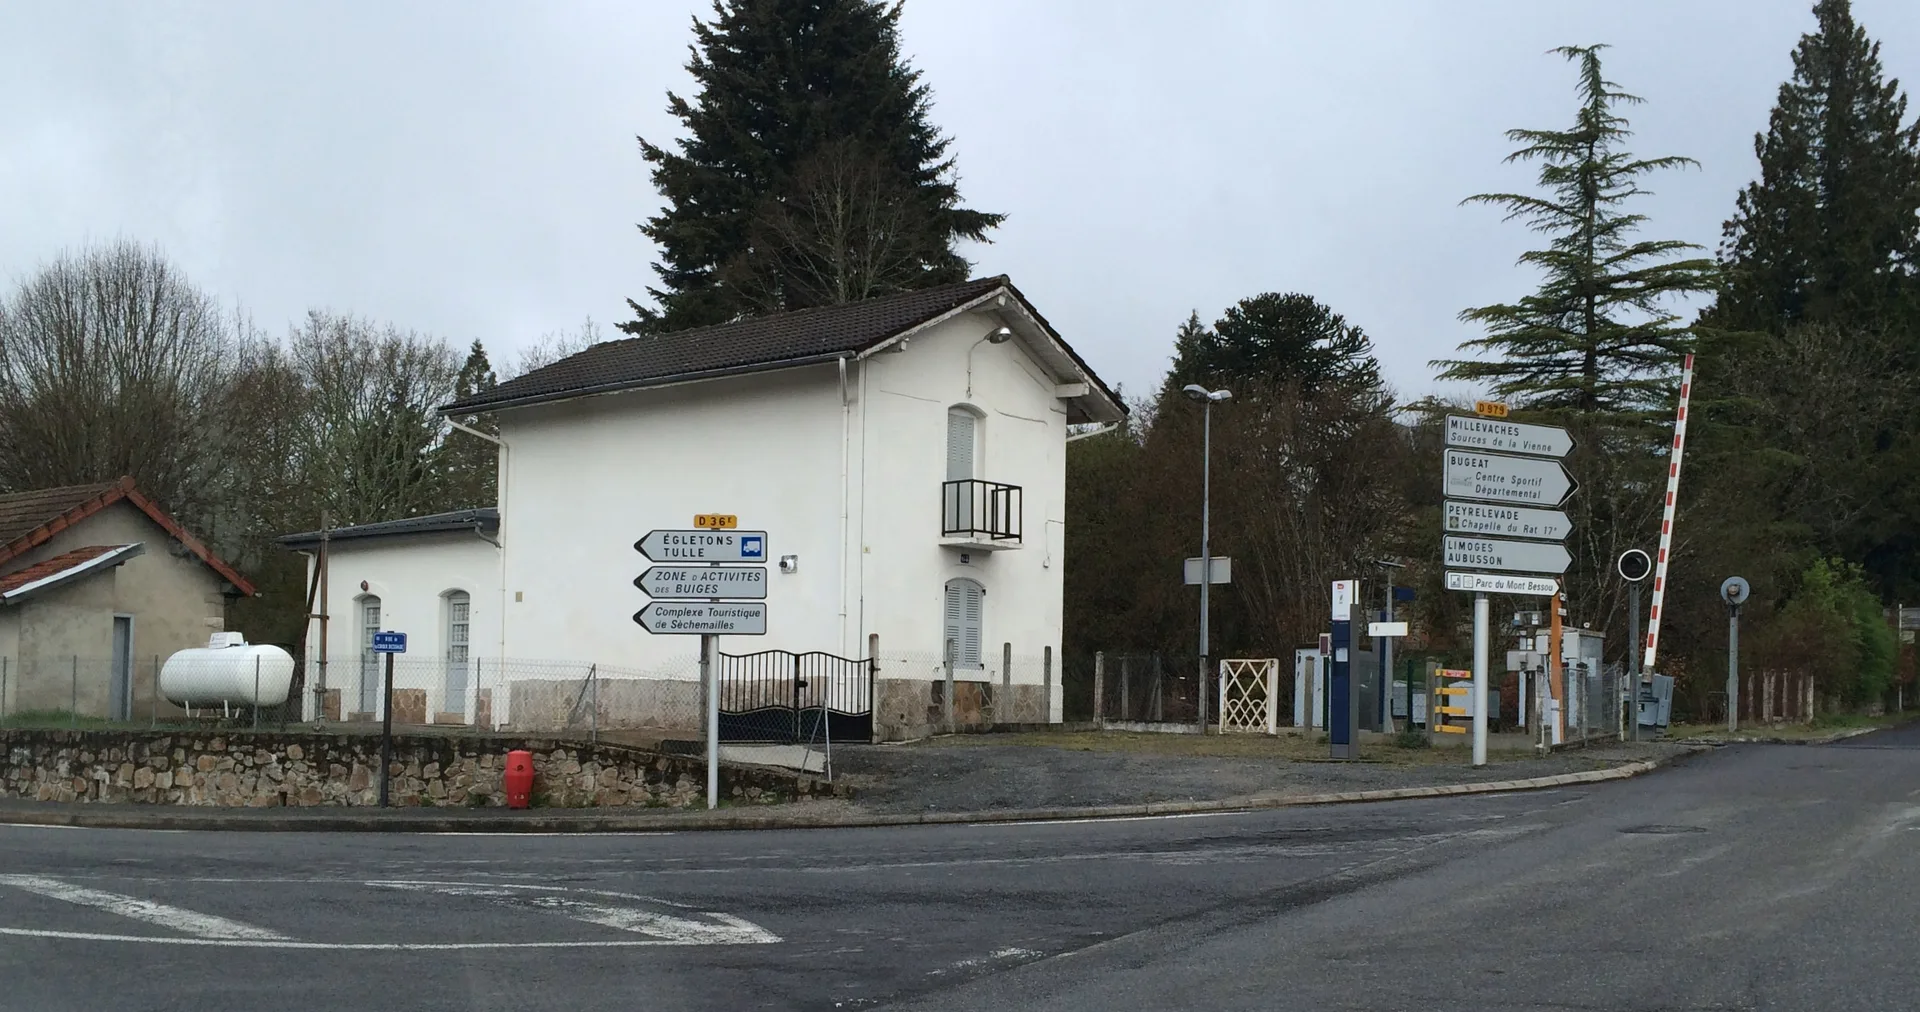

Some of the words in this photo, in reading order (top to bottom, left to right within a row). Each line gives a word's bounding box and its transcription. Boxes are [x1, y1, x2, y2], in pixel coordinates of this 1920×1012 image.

[1480, 404, 1484, 412] D
[1488, 405, 1504, 415] 979
[1451, 420, 1519, 436] MILLEVACHES
[1451, 432, 1486, 444] Sources
[1493, 437, 1502, 446] de
[1509, 439, 1516, 447] la
[1524, 441, 1551, 452] Vienne
[1451, 456, 1488, 468] BUGEAT
[1476, 472, 1504, 483] Centre
[1511, 476, 1542, 486] Sportif
[1449, 506, 1518, 520] PEYRELEVADE
[699, 517, 705, 525] D
[1462, 519, 1501, 531] Chapelle
[1508, 524, 1517, 532] du
[1524, 525, 1537, 534] Rat
[664, 534, 733, 545] ÉGLETONS
[664, 548, 704, 557] TULLE
[1448, 541, 1493, 552] LIMOGES
[1448, 553, 1502, 565] AUBUSSON
[655, 572, 686, 581] ZONE
[676, 584, 718, 593] BUIGES
[1476, 579, 1492, 588] Parc
[1495, 579, 1504, 588] du
[1506, 580, 1525, 590] Mont
[1528, 582, 1553, 591] Bessou
[656, 607, 703, 619] Complexe
[708, 608, 760, 619] Touristique
[671, 620, 734, 629] Sèchemailles
